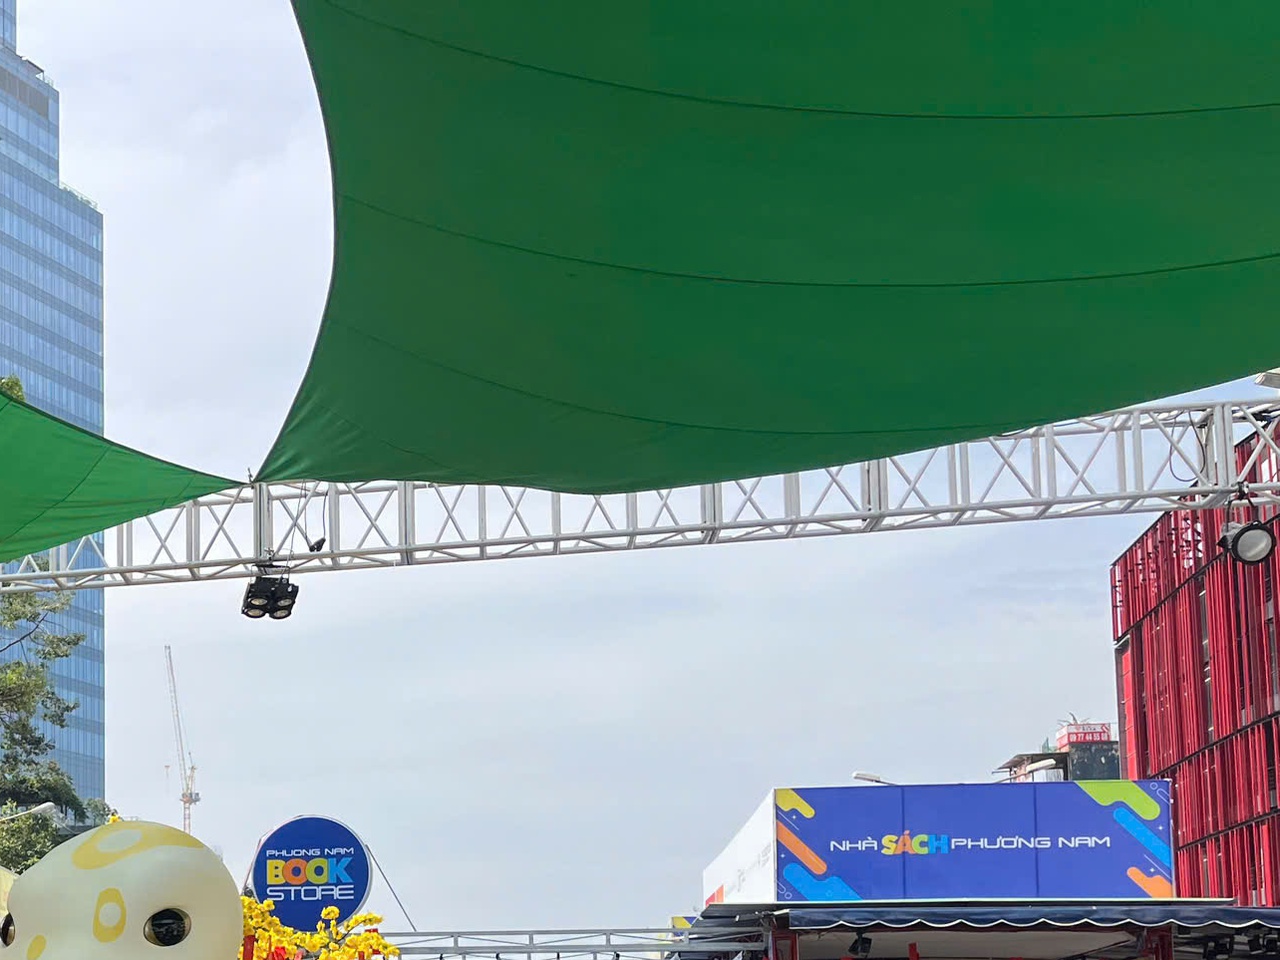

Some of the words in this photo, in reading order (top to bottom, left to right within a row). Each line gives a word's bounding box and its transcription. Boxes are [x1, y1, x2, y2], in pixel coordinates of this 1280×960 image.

[266, 849, 321, 857] PHUONG
[324, 847, 355, 855] NAM
[830, 837, 878, 851] NHÀ
[881, 830, 949, 855] SÁCH
[951, 836, 1051, 849] PHƯƠNG
[1058, 837, 1110, 848] NAM
[266, 857, 354, 885] BOOK
[266, 885, 355, 901] STORE
